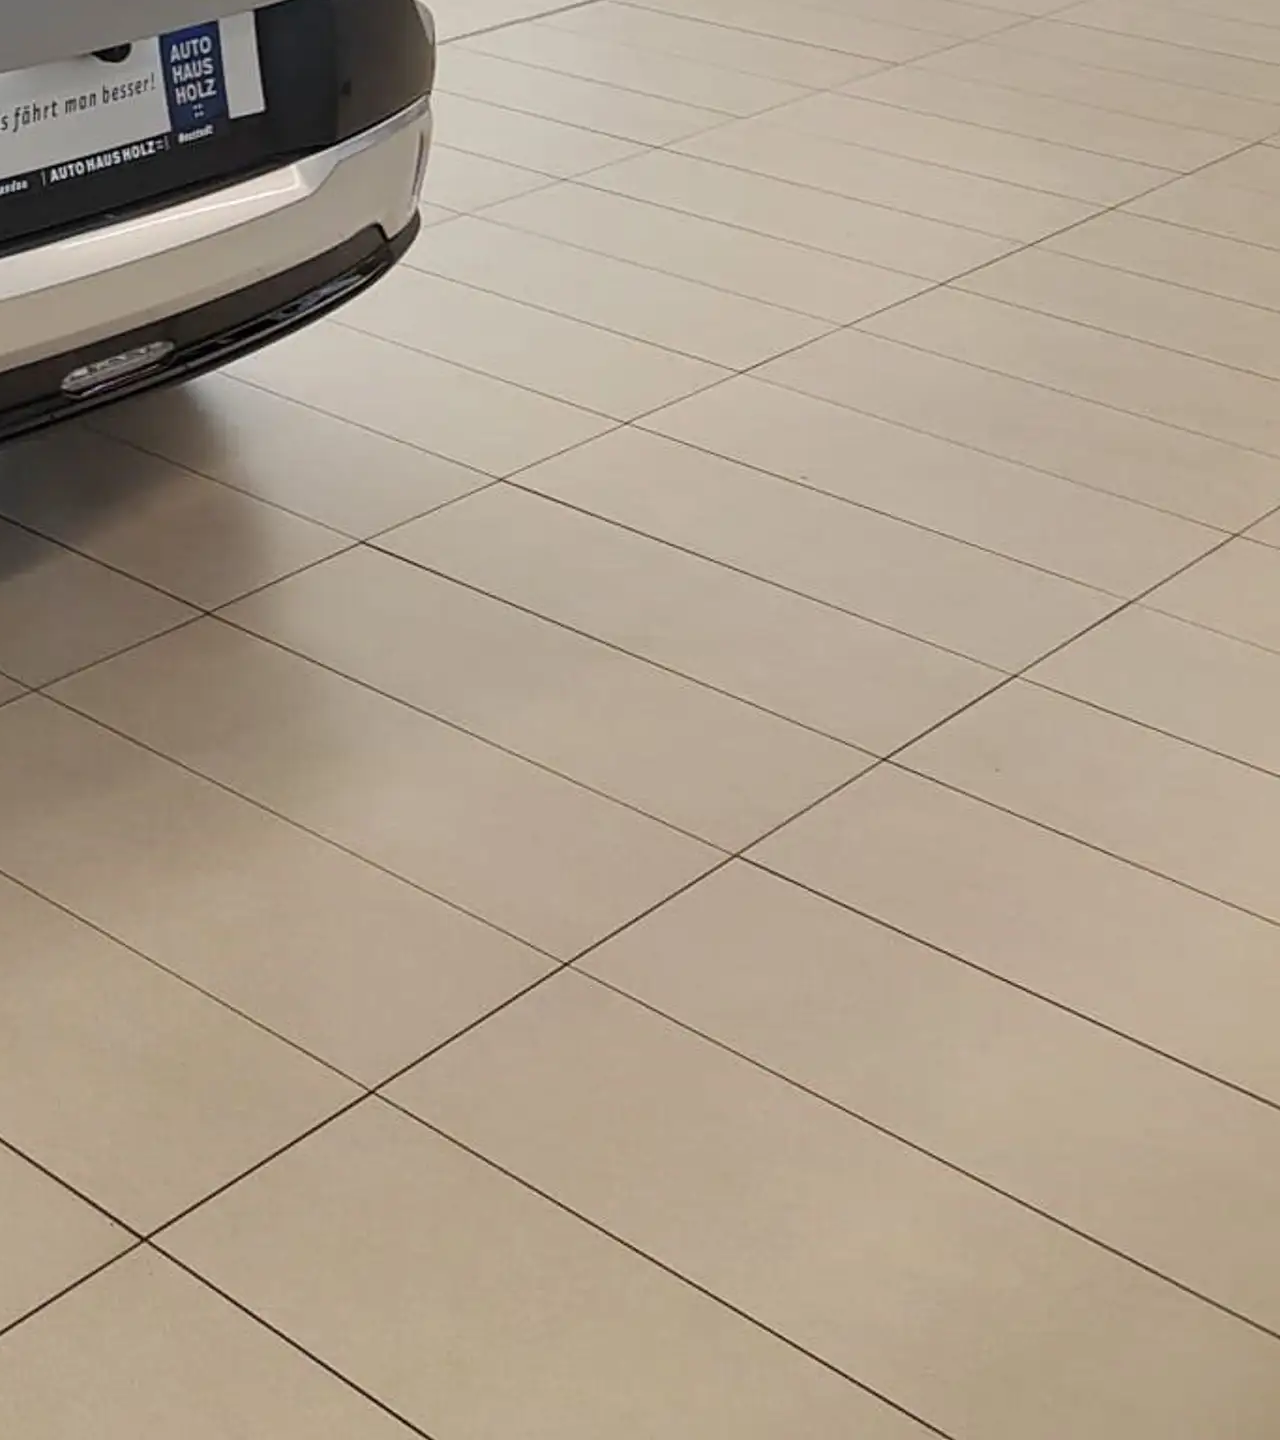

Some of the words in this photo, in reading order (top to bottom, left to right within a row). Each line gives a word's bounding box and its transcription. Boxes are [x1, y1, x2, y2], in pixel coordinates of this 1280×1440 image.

[170, 35, 212, 63] AUTO
[171, 58, 214, 84] HAUS
[12, 100, 59, 133] fährt
[64, 91, 97, 114] man
[101, 71, 157, 105] besser!
[174, 78, 218, 105] HOLZ
